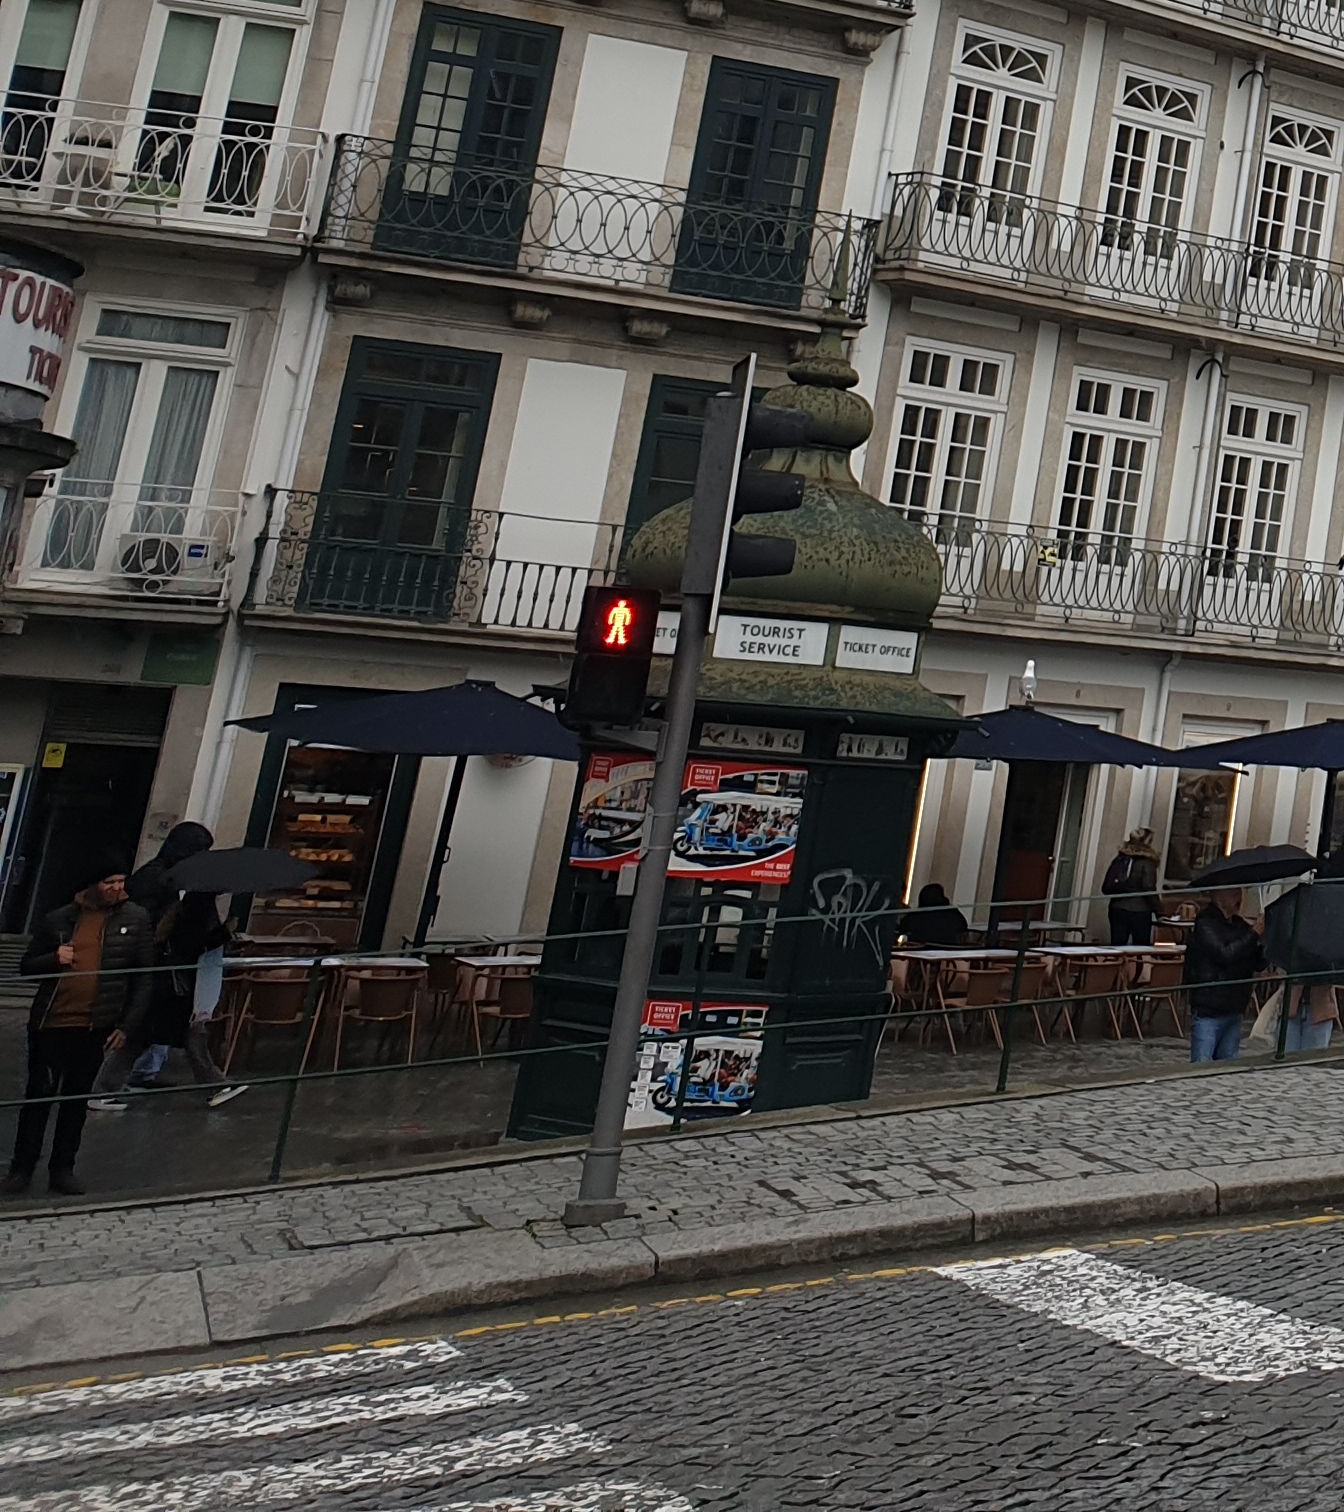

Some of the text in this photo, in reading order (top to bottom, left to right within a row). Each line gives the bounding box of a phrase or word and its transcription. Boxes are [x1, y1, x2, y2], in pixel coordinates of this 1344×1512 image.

[740, 623, 807, 640] TOURIST
[739, 640, 802, 657] SERVICE
[842, 641, 912, 658] TICKET OFFICE
